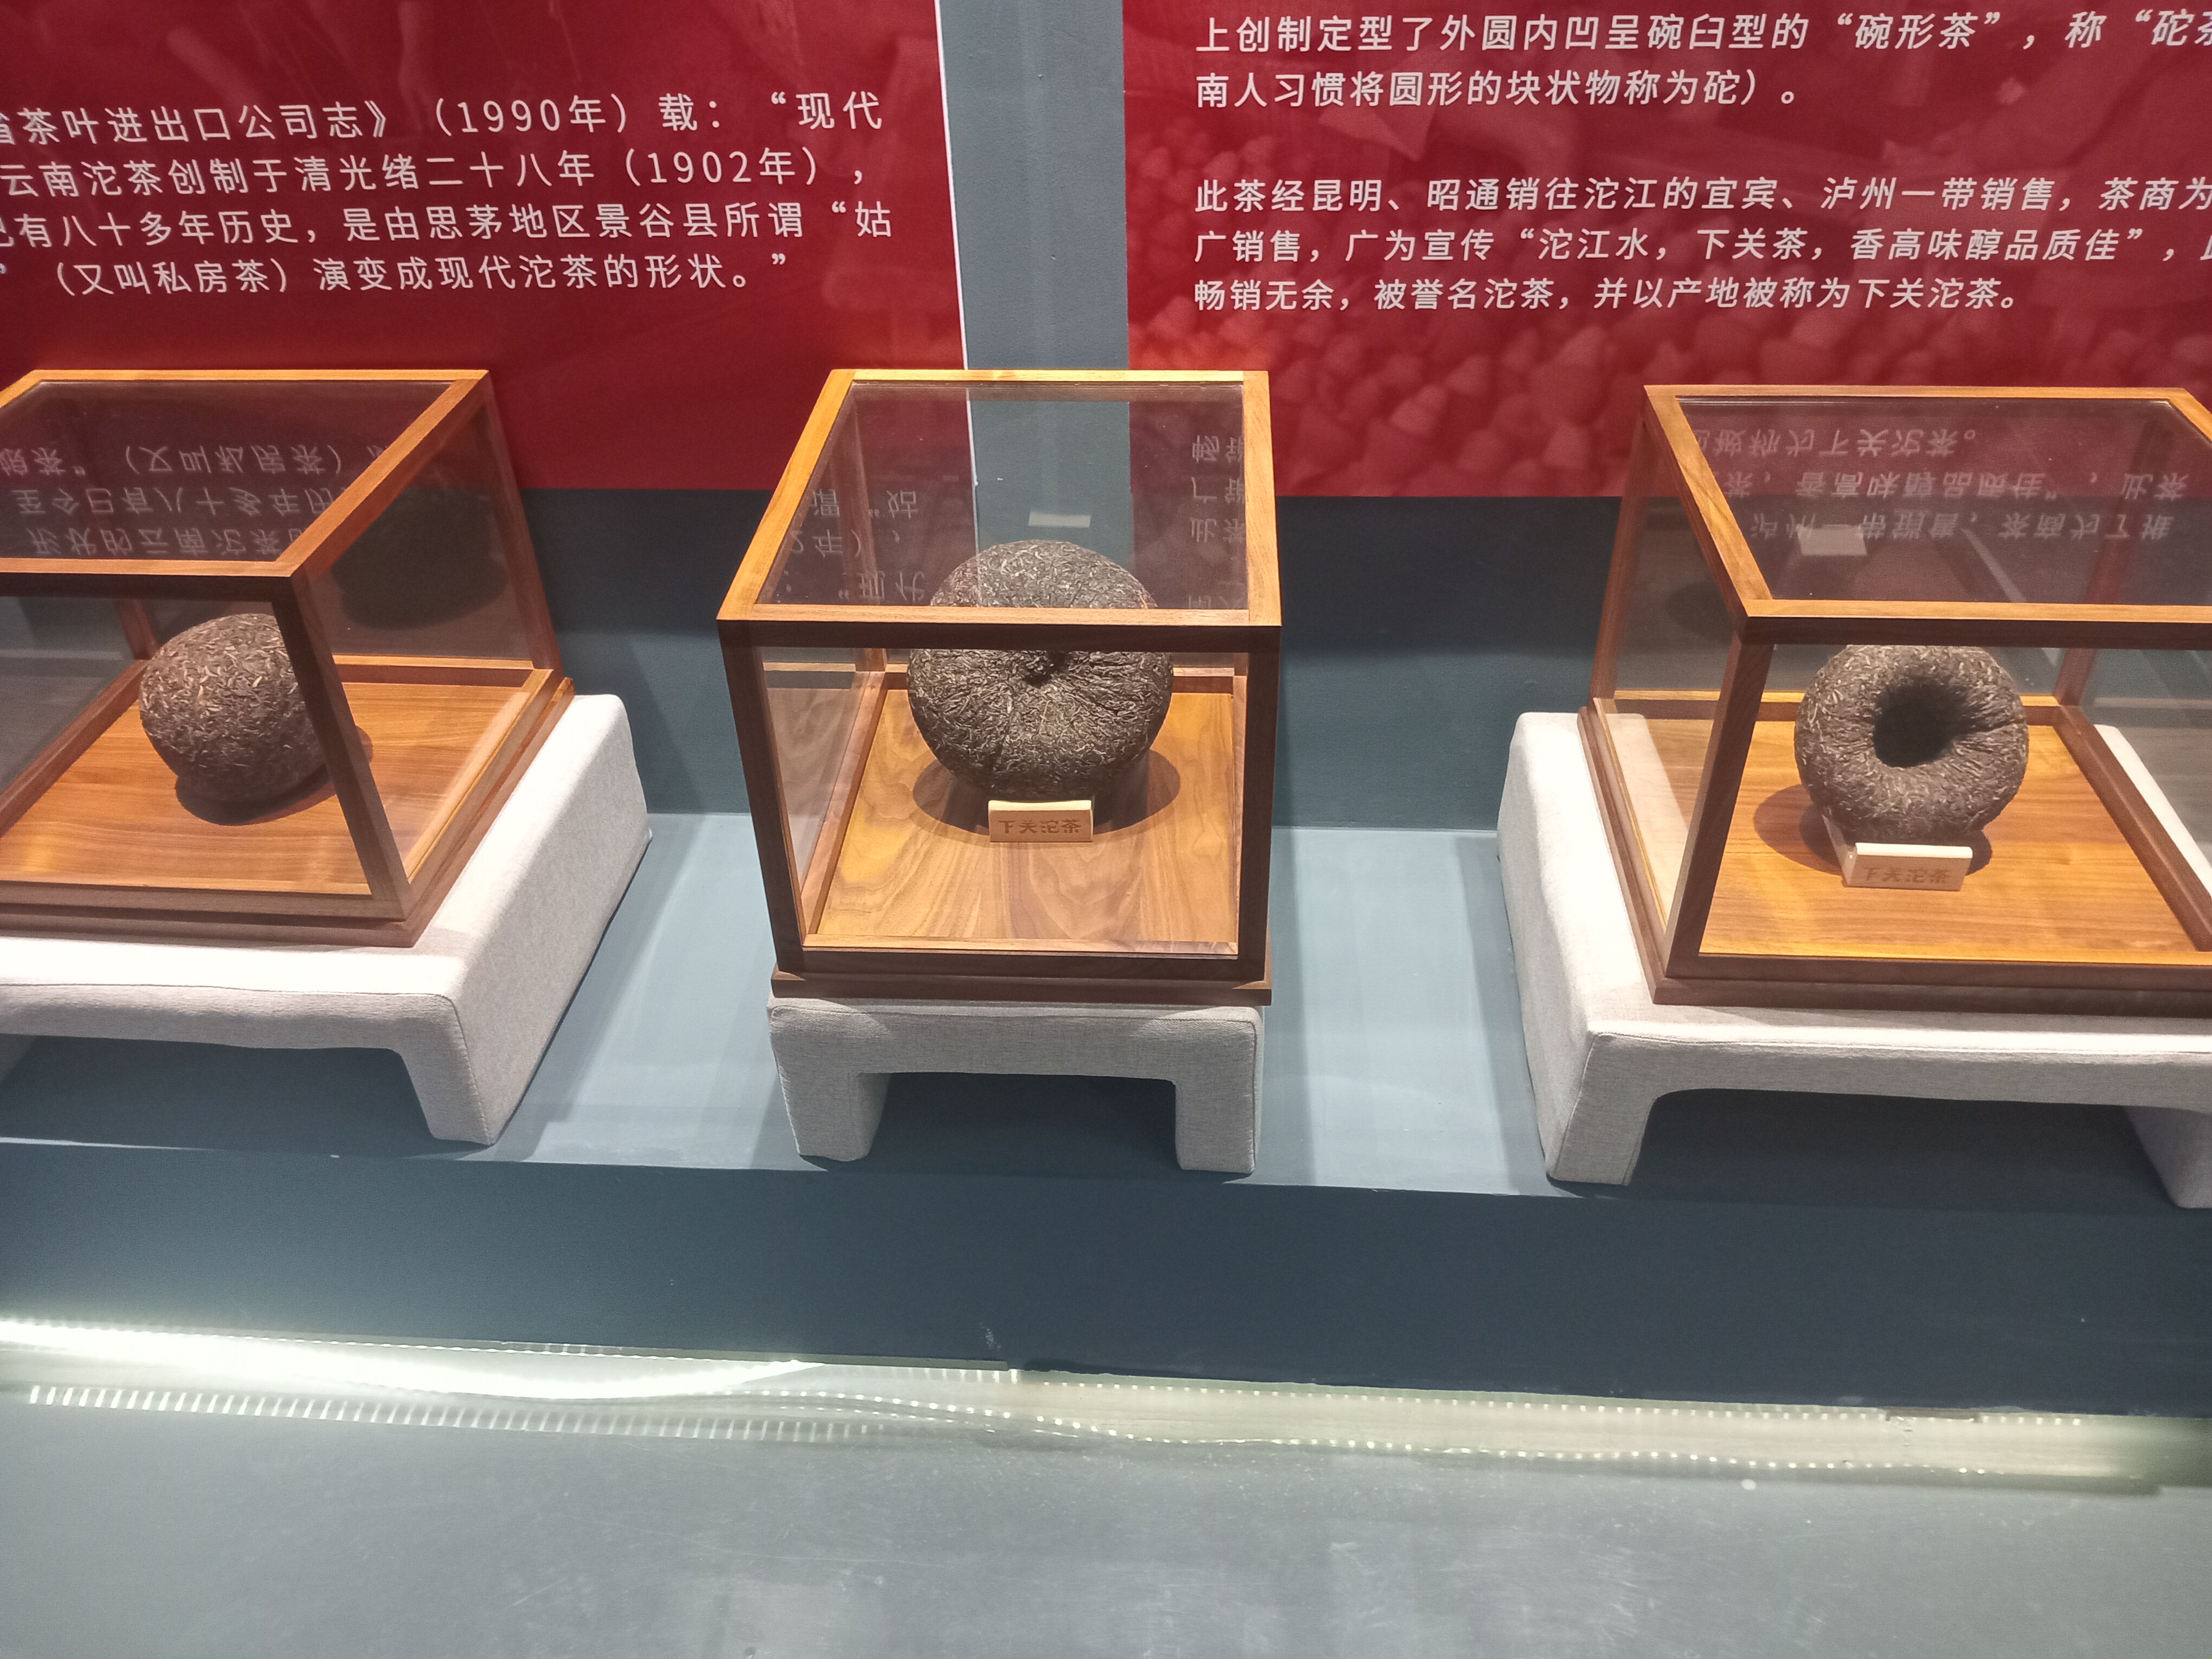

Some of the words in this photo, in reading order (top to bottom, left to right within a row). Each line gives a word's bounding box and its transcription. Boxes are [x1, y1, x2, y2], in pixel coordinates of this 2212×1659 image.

[1196, 69, 1795, 108] 南人习惯将圆形的块状物称为砣）。
[0, 146, 863, 197] 云南沱茶创制于清光绪二十八年（1902年），
[1194, 177, 2212, 213] 此茶经昆明、昭通销往沱江的宜宾、泸州一带销售，茶商为
[1194, 278, 2014, 312] 畅销无余，被誉名沱茶，并以产地被称为下关沱茶。
[998, 819, 1082, 834] 下关沱茶
[1862, 867, 1951, 884] 下关沱茶
